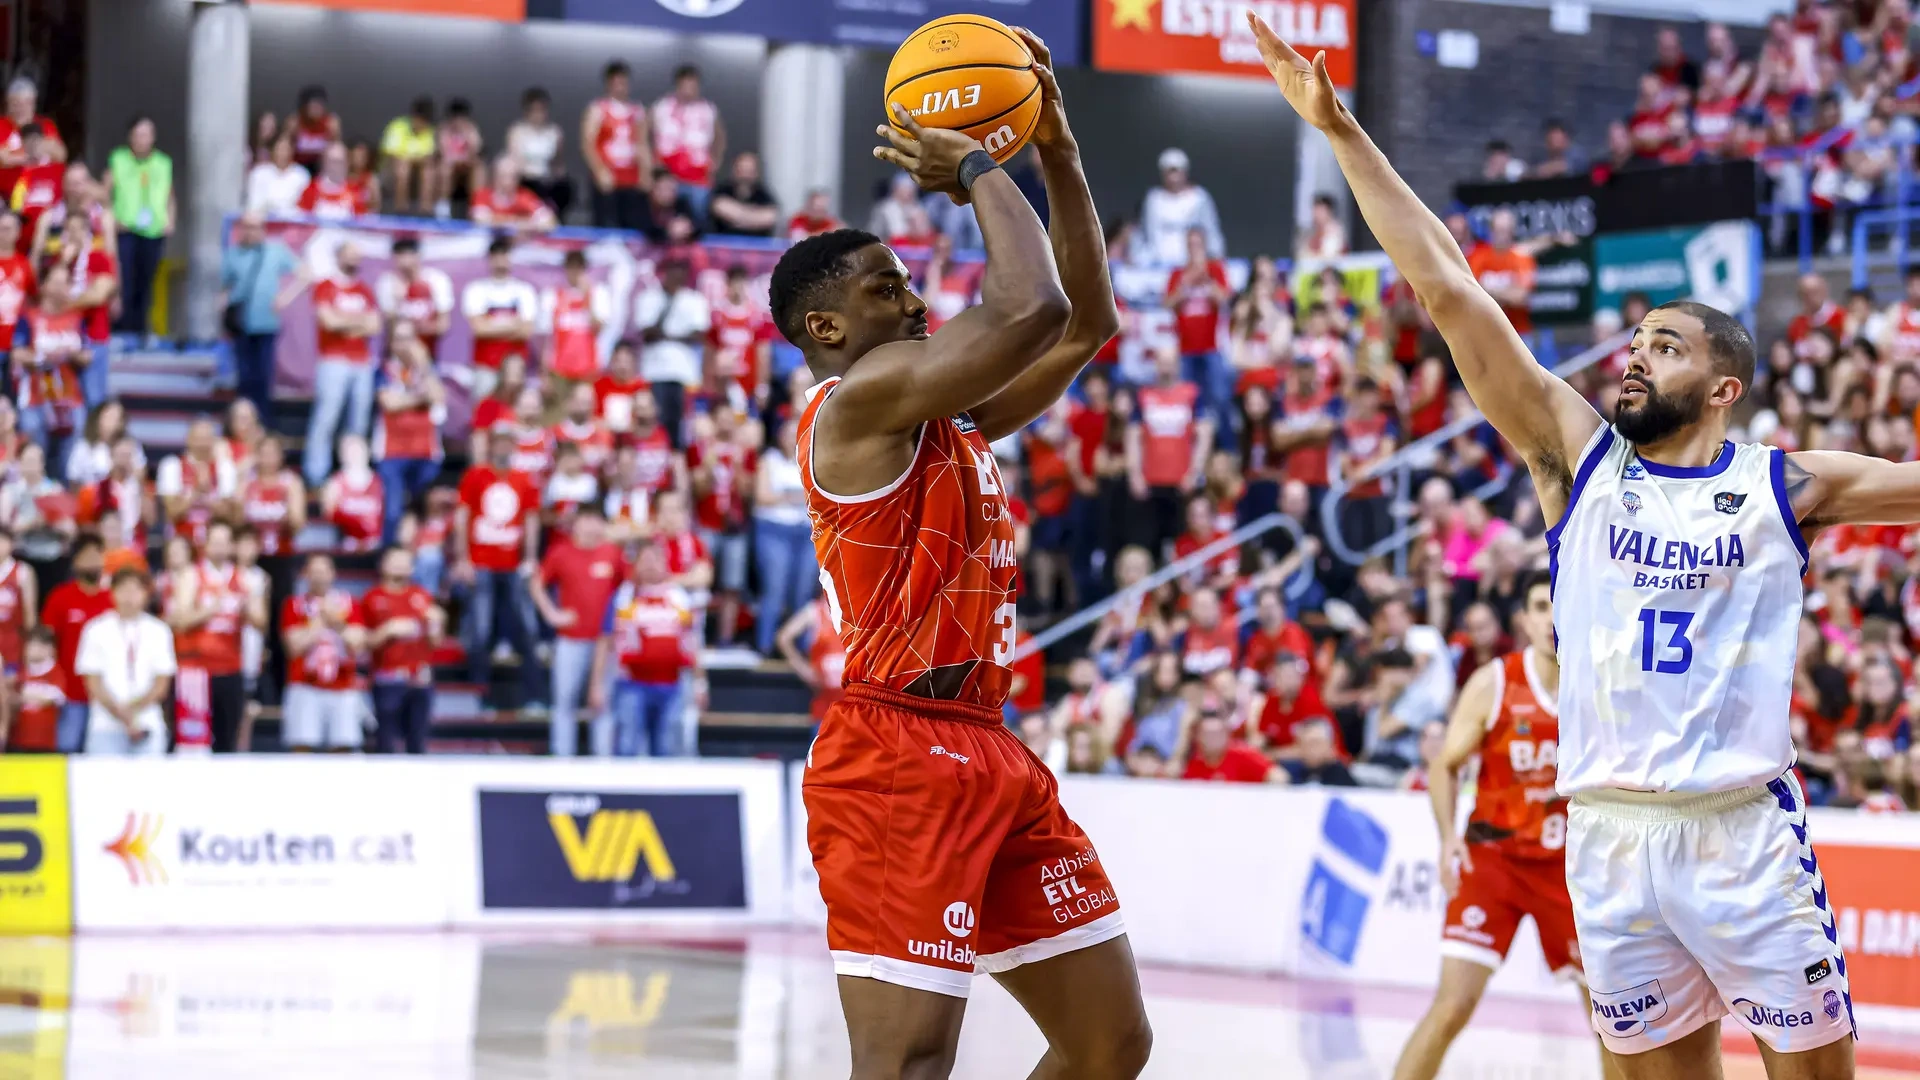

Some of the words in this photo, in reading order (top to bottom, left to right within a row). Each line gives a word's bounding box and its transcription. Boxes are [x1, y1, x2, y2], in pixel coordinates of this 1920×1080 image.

[907, 107, 922, 117] NX
[922, 84, 981, 116] EVO
[1609, 523, 1745, 571] VALENCIA
[1633, 571, 1710, 590] BASKET
[1637, 608, 1695, 675] 13
[1509, 739, 1558, 772] BA
[1042, 875, 1086, 906] ETL
[1052, 886, 1117, 923] GLOBAL
[1808, 967, 1828, 983] acb
[1592, 994, 1659, 1019] PULEVA
[1745, 1004, 1814, 1028] Midea
